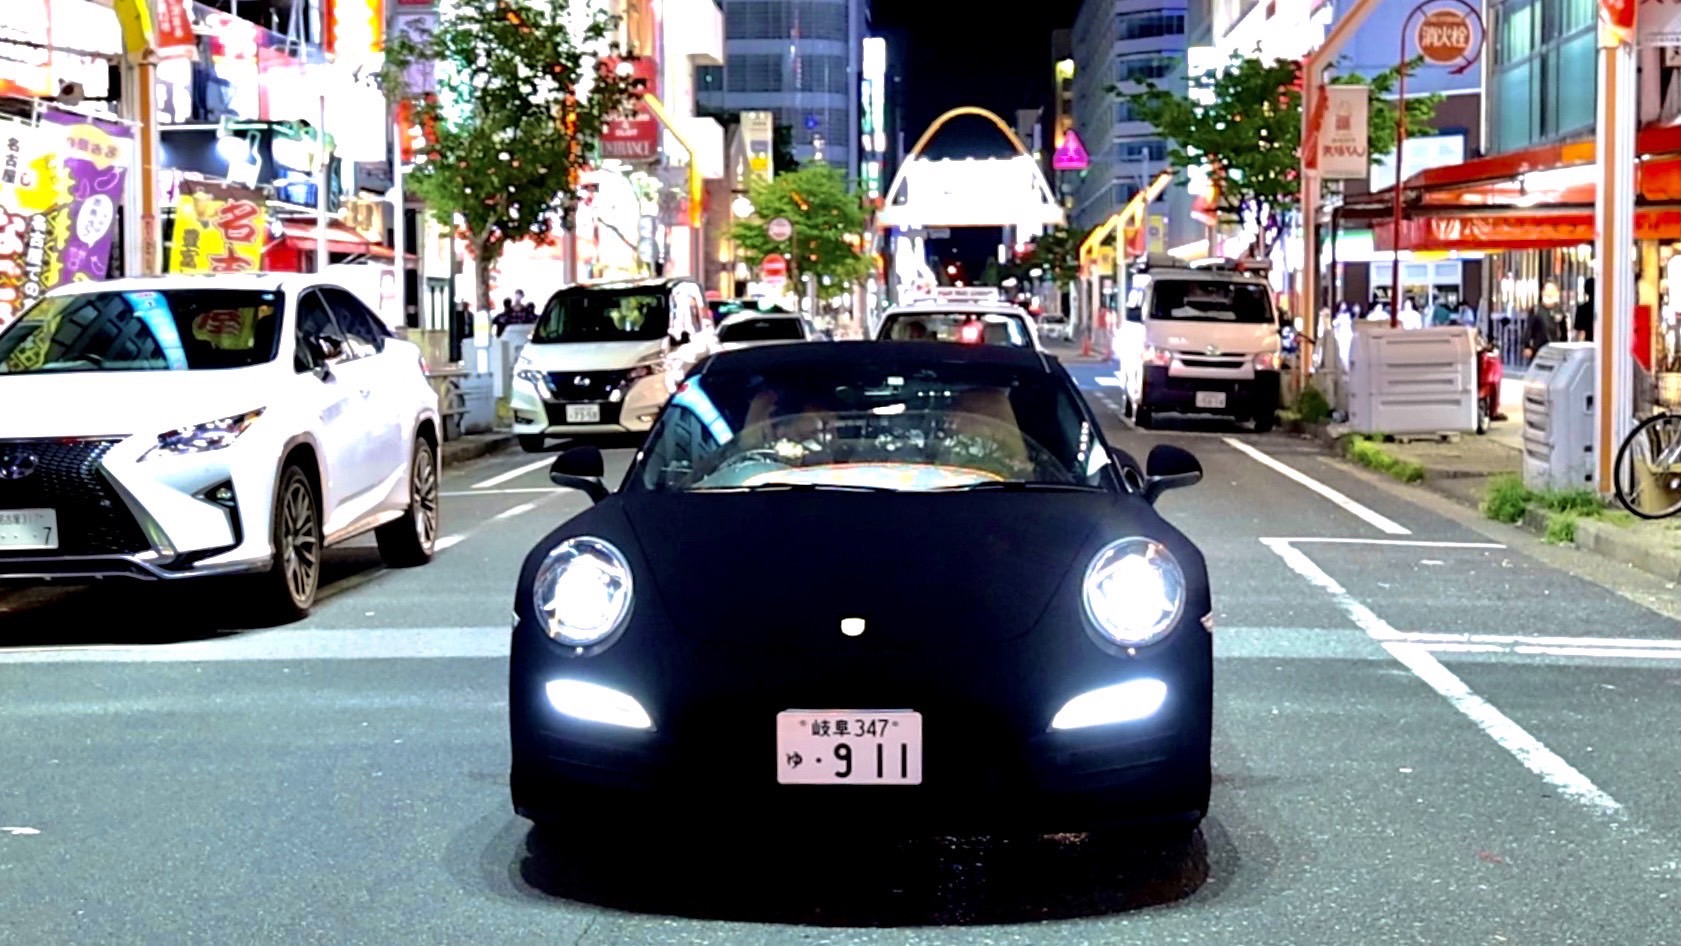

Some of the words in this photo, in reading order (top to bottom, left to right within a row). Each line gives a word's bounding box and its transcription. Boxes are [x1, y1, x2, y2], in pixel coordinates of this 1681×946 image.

[1422, 25, 1468, 48] 消火栓
[3, 137, 19, 184] 名古屋
[786, 751, 803, 769] ゆ
